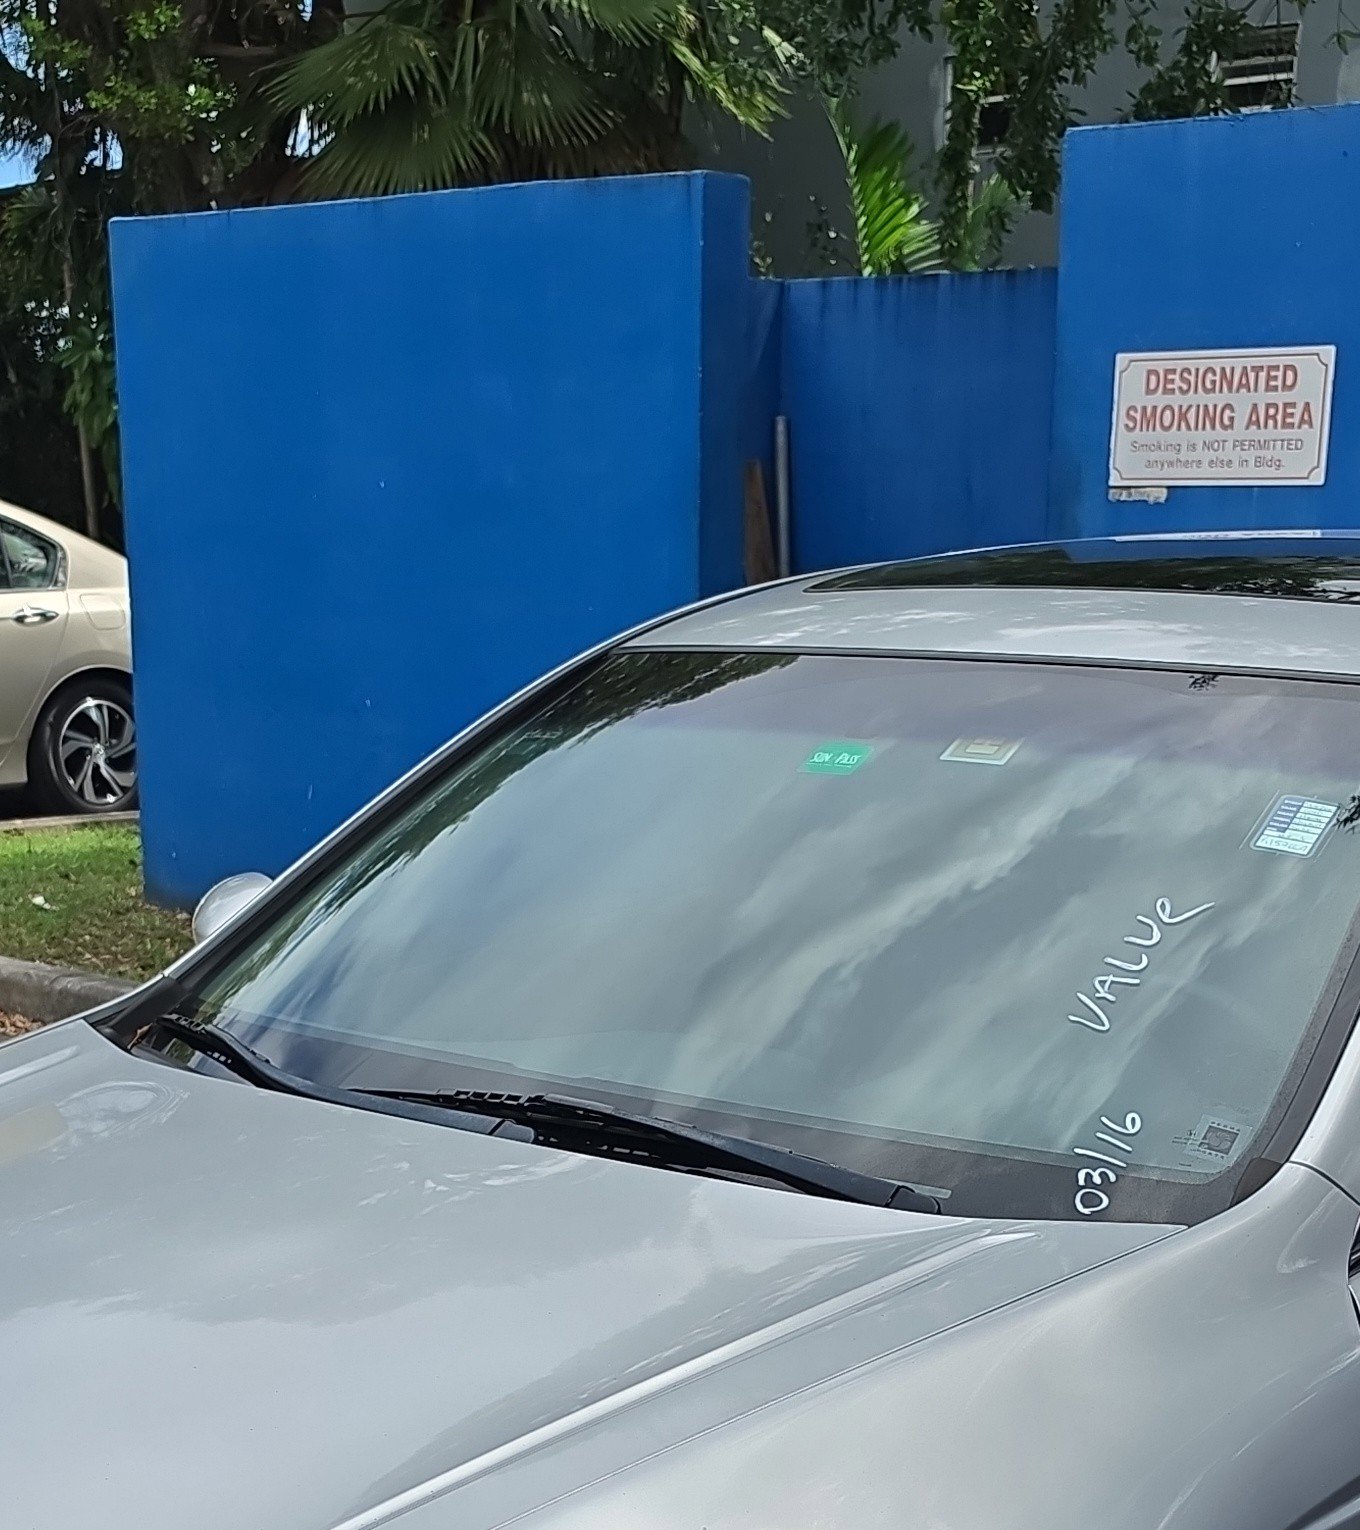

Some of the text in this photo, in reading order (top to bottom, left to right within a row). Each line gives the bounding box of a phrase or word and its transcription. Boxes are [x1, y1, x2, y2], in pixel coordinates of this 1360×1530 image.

[1144, 363, 1299, 396] DESIGNATED
[1123, 402, 1314, 433] SMOKING AREA
[1130, 438, 1305, 454] Smoking is NOT PERMITTED
[1144, 456, 1286, 471] anywhere else in Bldg.
[1074, 1110, 1143, 1215] 03/16
